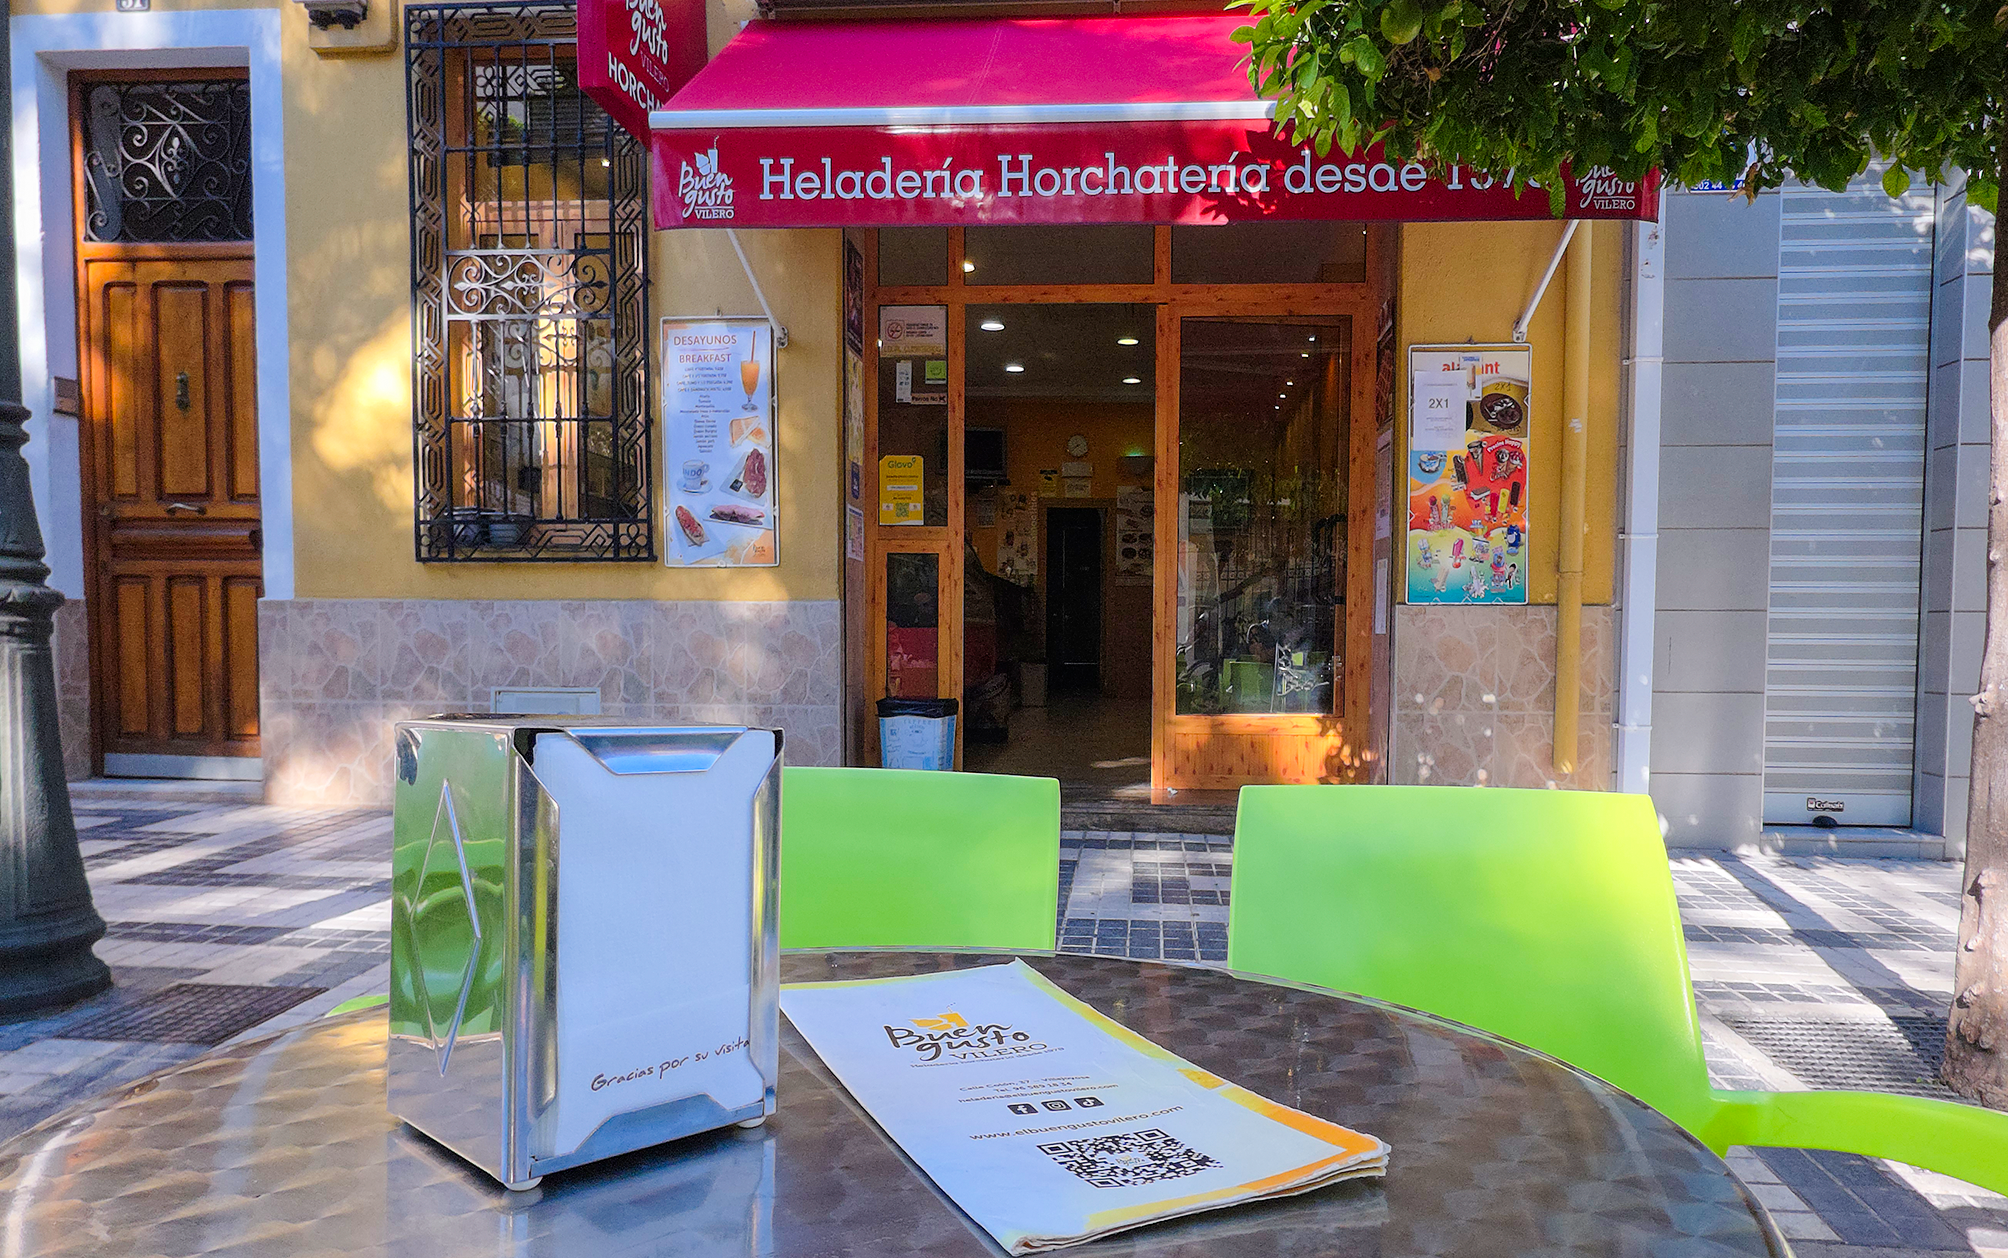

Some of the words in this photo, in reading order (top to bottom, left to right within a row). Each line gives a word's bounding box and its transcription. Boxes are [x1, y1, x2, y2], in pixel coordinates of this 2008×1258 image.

[629, 10, 668, 65] gusto
[640, 50, 669, 93] VILERO
[678, 160, 733, 197] Buen
[759, 156, 985, 200] Heladería
[997, 151, 1270, 197] Horchatería
[1283, 149, 1427, 194] desde
[682, 185, 734, 218] gusto
[695, 208, 735, 219] VILERO
[1593, 199, 1636, 210] VILERO
[673, 334, 738, 346] DESAYUNOS
[679, 353, 732, 363] BREAKFAST
[1428, 398, 1450, 409] 2X1
[888, 459, 914, 469] Glovo
[883, 1023, 1014, 1049] Buen
[915, 1030, 1031, 1062] gusto
[590, 1066, 654, 1092] Gracias
[658, 1055, 690, 1080] por
[694, 1050, 709, 1063] su
[714, 1035, 750, 1057] visita
[948, 1042, 1048, 1060] VILERO
[969, 1104, 1184, 1141] www.elbuengustovilero.com
